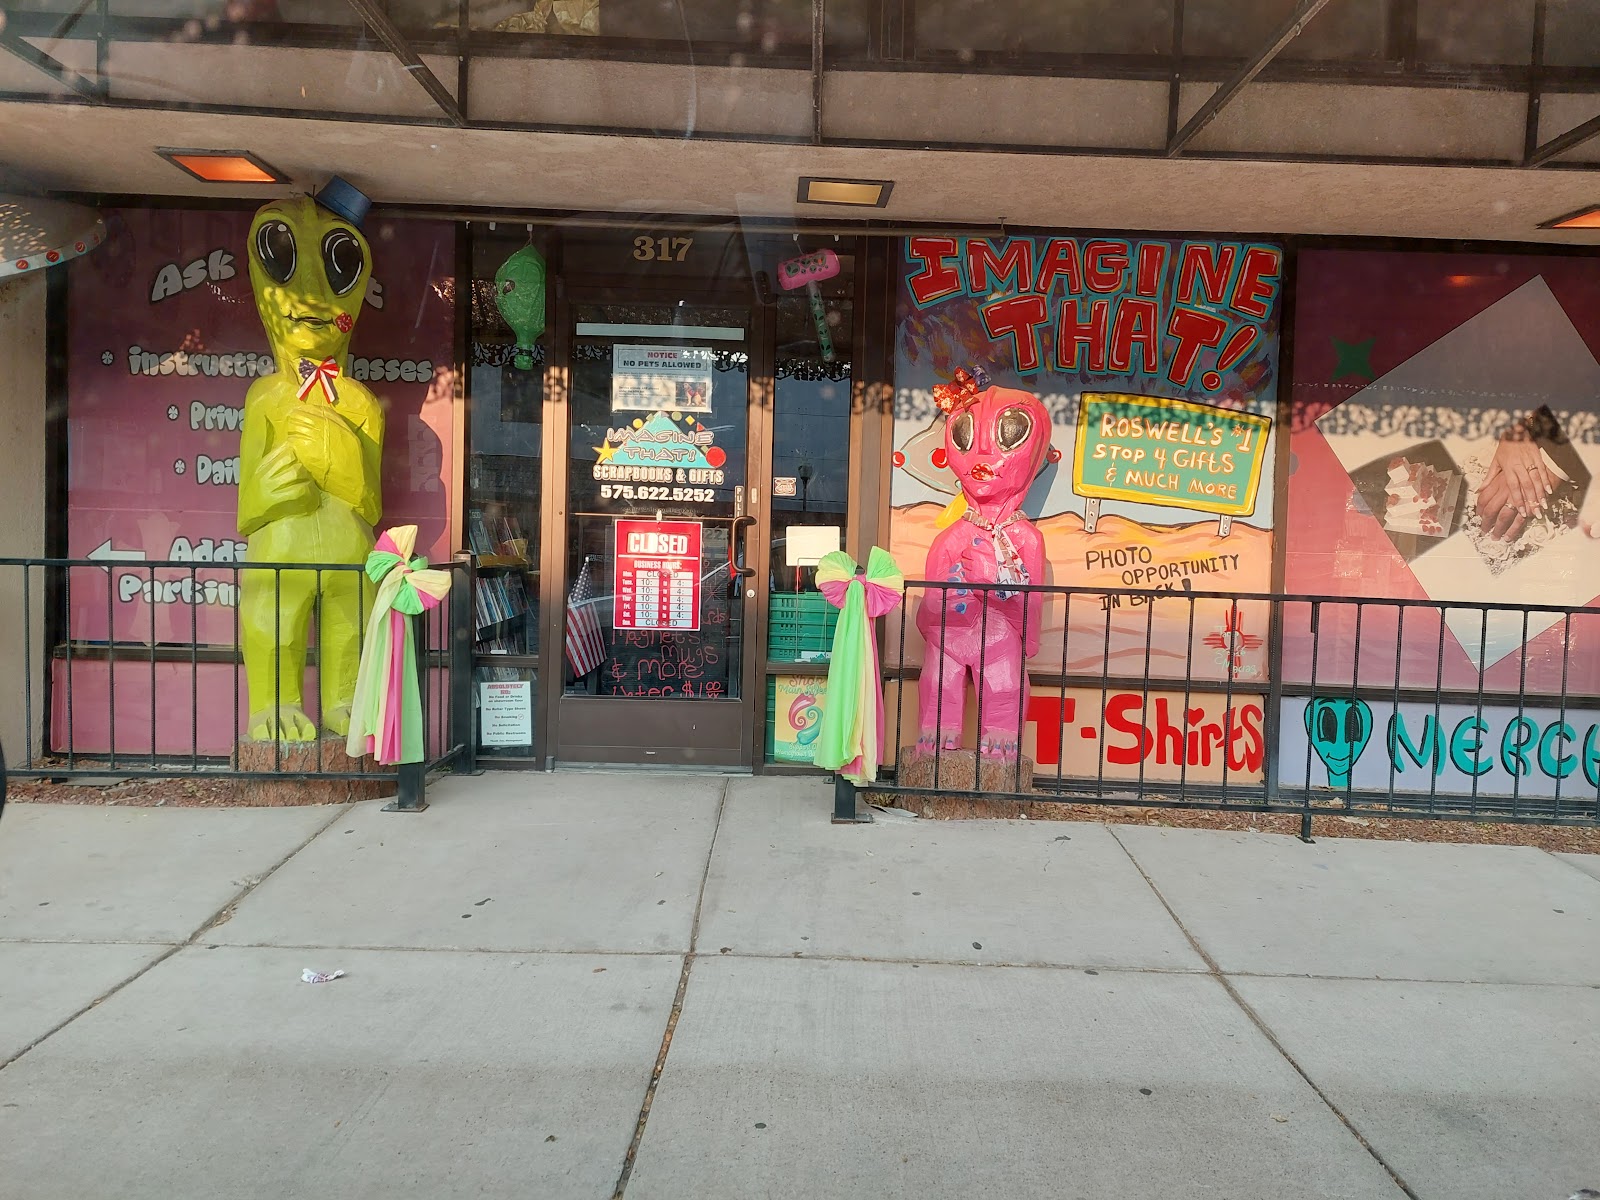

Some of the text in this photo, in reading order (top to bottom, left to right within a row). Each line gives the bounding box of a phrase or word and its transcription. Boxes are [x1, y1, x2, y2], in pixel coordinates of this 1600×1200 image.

[633, 236, 694, 261] 317
[151, 250, 236, 301] Ask
[908, 236, 1282, 319] IMAGINE
[981, 295, 1259, 390] THAT!
[348, 354, 434, 382] lasses
[638, 360, 660, 368] PETS
[661, 361, 702, 369] ALLOWED
[606, 427, 715, 445] IMAGINE
[1101, 412, 1252, 452] ROSWELL'S #1
[623, 446, 697, 462] THAT!
[1092, 443, 1146, 464] STOP
[1154, 448, 1166, 470] 4
[196, 454, 241, 485] Dail
[593, 464, 725, 485] SCRAPBOOKS & GIFTS
[600, 484, 715, 503] 575.622.5252
[1124, 470, 1180, 491] MUCH
[1188, 479, 1237, 500] MORE
[628, 533, 688, 554] CLOSED
[633, 559, 683, 570] BUSINESS HOURS:
[1085, 546, 1153, 570] PHOTO
[1121, 554, 1240, 586] OPPORTUNITY
[646, 571, 679, 579] CLOSED
[118, 574, 241, 607] Parkin
[1099, 594, 1121, 611] IN
[1026, 693, 1264, 773] T-Shirts
